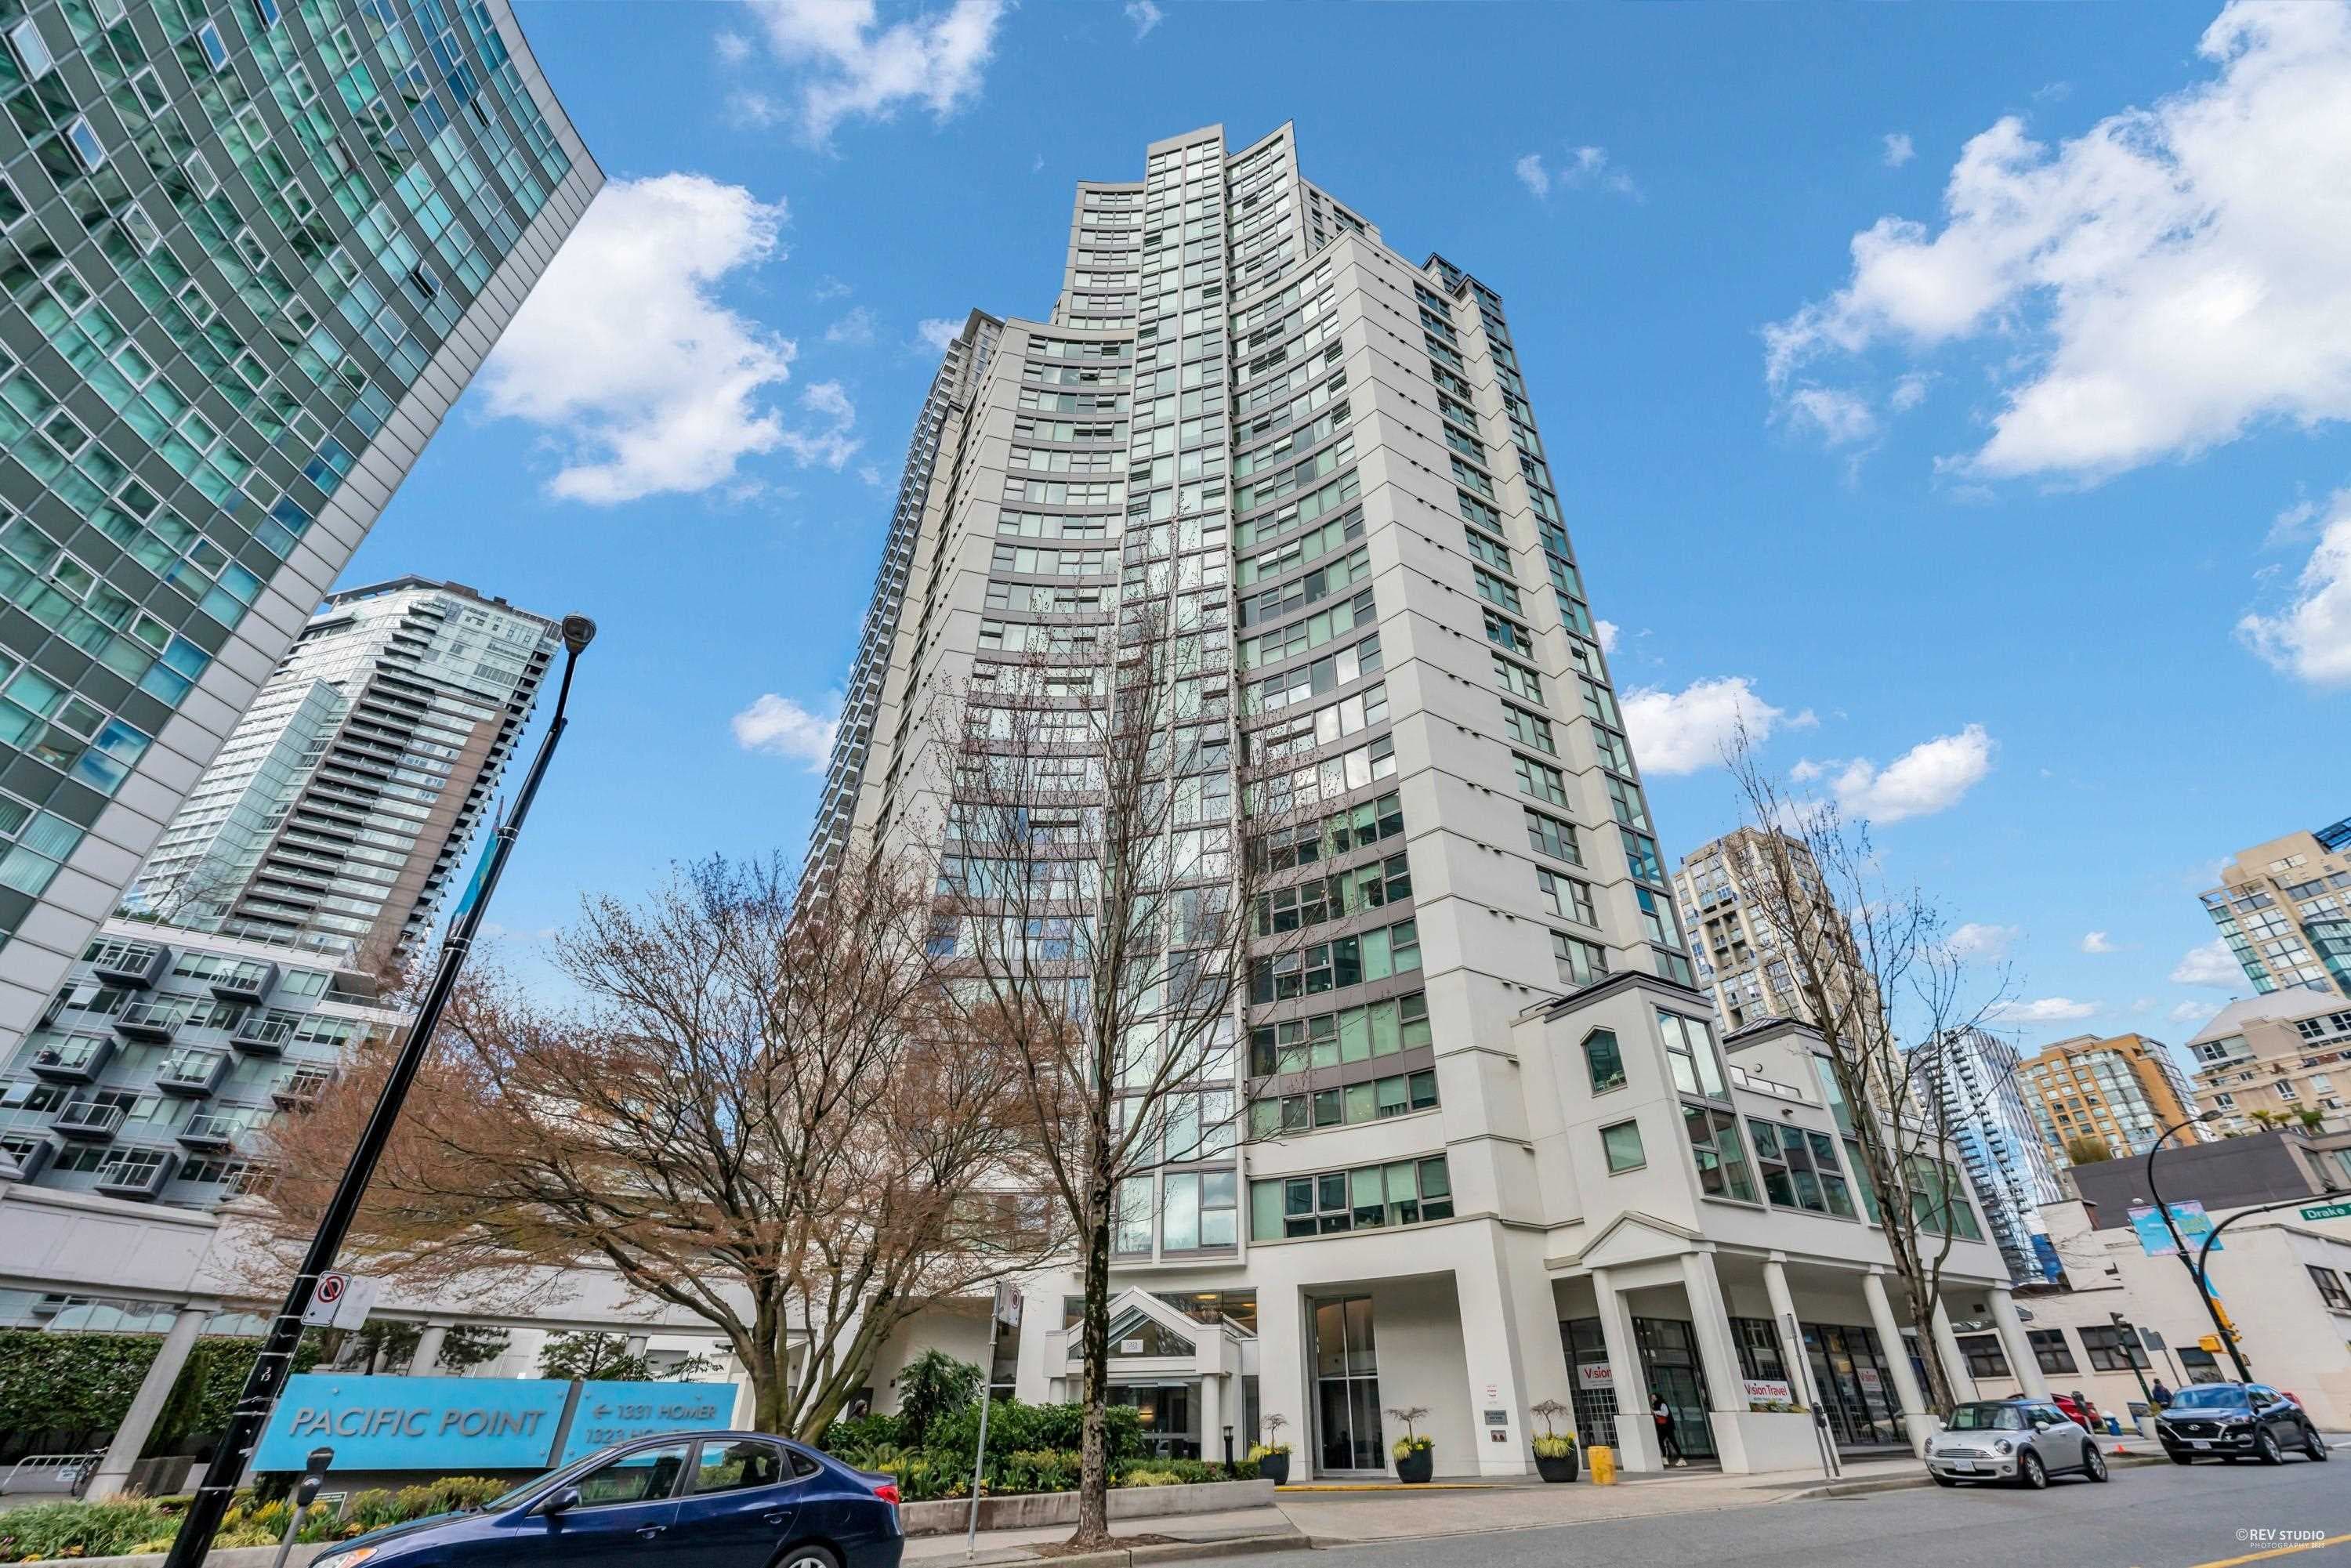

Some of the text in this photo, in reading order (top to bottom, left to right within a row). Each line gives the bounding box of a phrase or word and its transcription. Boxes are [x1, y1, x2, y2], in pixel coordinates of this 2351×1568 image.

[2306, 1208, 2345, 1219] Drake
[1766, 1385, 1788, 1396] Travel
[617, 1404, 715, 1421] 1331 HOMER
[288, 1408, 546, 1436] PACIFIC POINT
[586, 1429, 626, 1443] 1323
